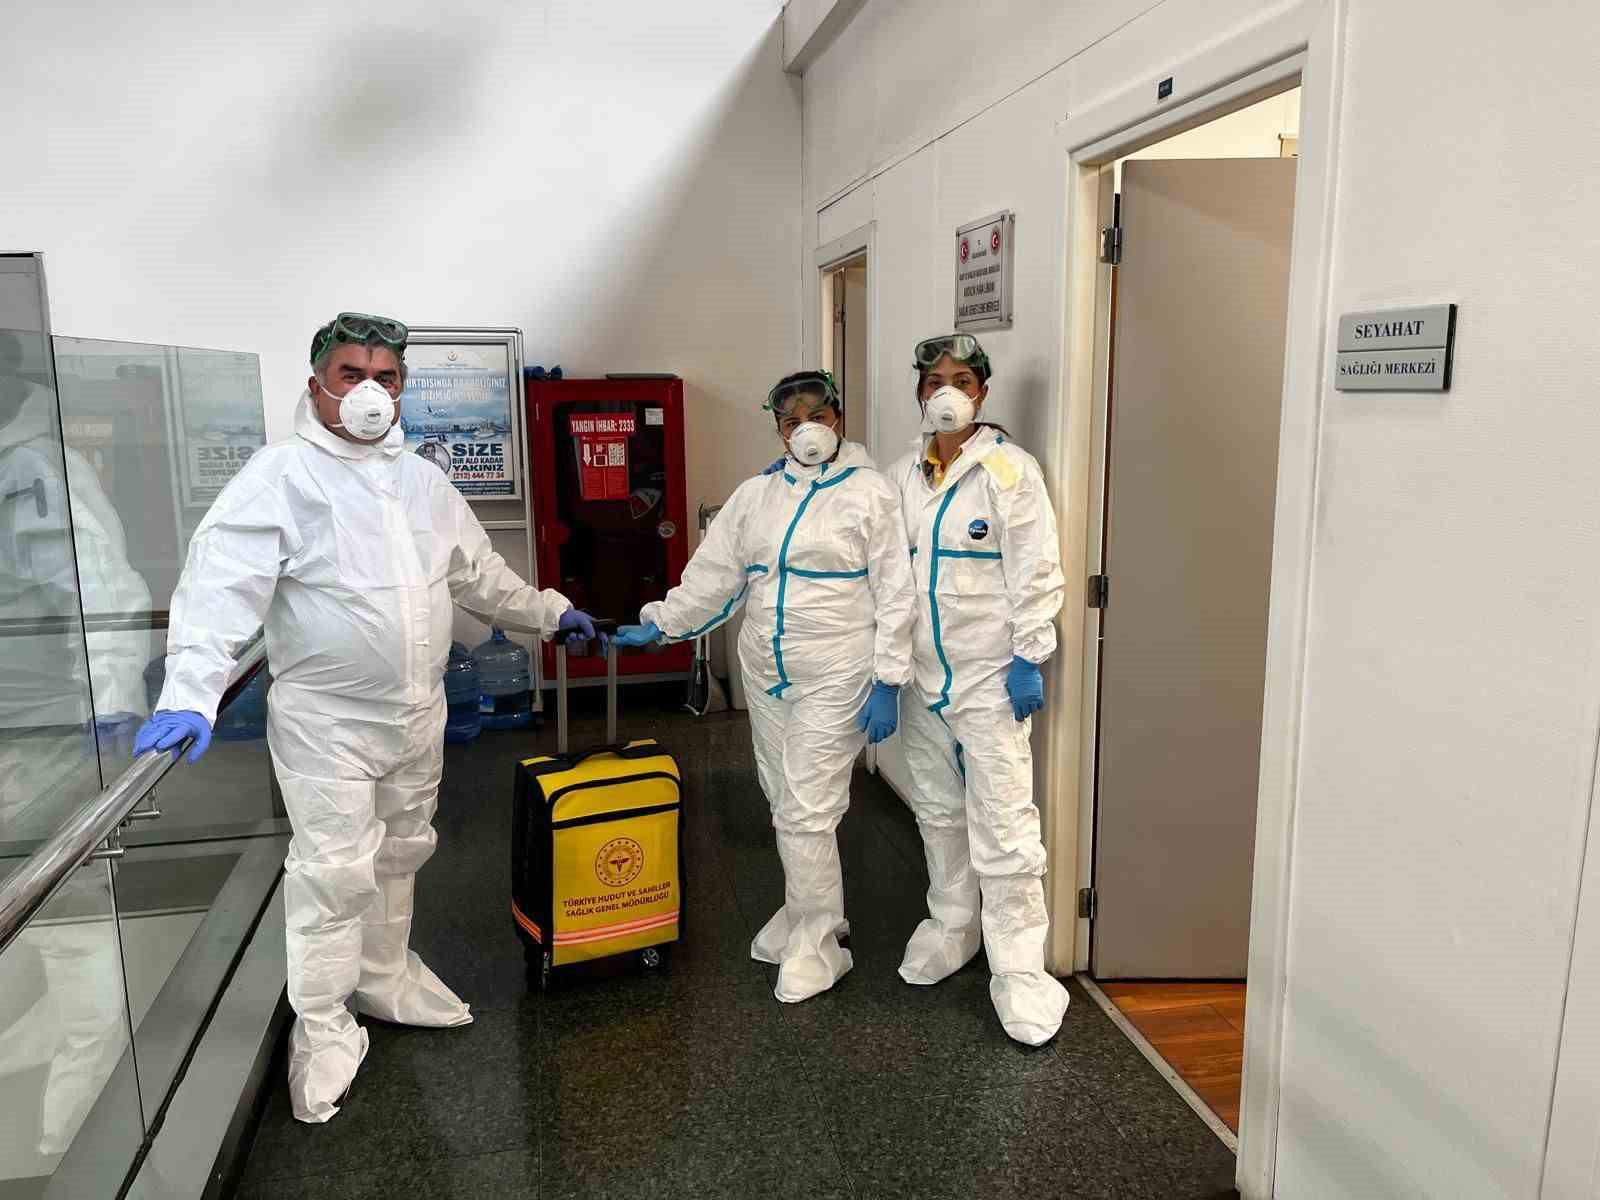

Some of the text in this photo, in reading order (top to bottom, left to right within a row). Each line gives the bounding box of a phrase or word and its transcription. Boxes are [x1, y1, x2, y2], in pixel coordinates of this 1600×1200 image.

[1354, 320, 1424, 339] SEYAHAT
[1340, 358, 1436, 375] SAĞLIĞI MERKEZİ
[571, 419, 595, 433] YANGIN
[619, 419, 635, 432] 2333
[563, 881, 671, 908] TÜRKİYE HUDUT VE SAHİLLER
[565, 905, 594, 917] SAĞLIK
[595, 902, 620, 913] GENEL
